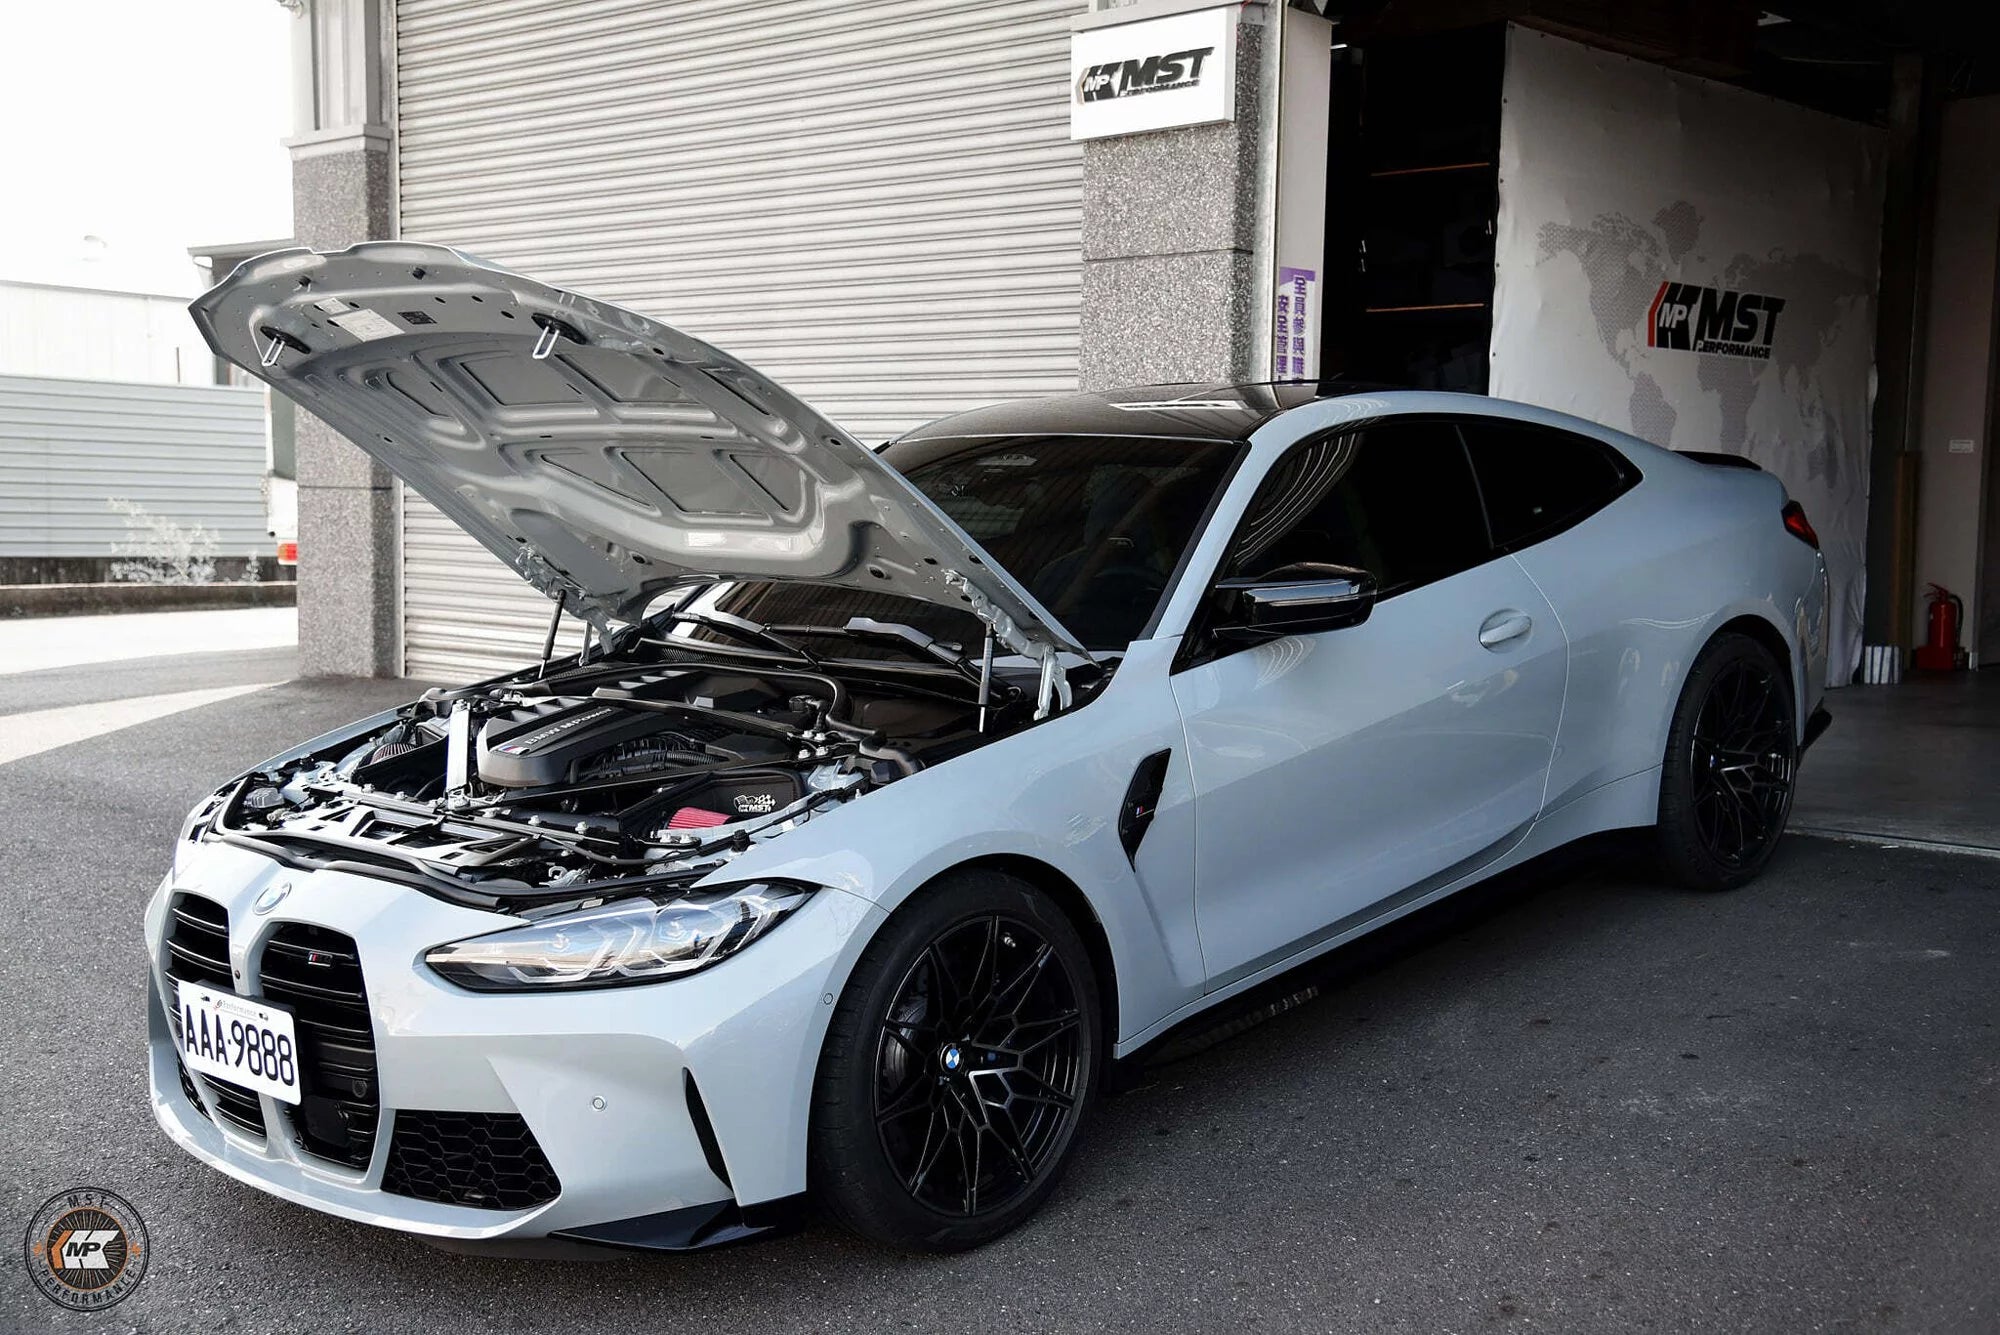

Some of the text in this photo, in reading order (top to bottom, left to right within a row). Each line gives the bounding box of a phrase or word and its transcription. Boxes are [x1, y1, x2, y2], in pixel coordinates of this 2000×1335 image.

[1118, 47, 1215, 97] MST
[1276, 295, 1289, 380] 安全管理
[1292, 276, 1306, 380] 全員參與職
[1658, 287, 1786, 350] MP MST
[1697, 339, 1771, 359] PERFORMANCE
